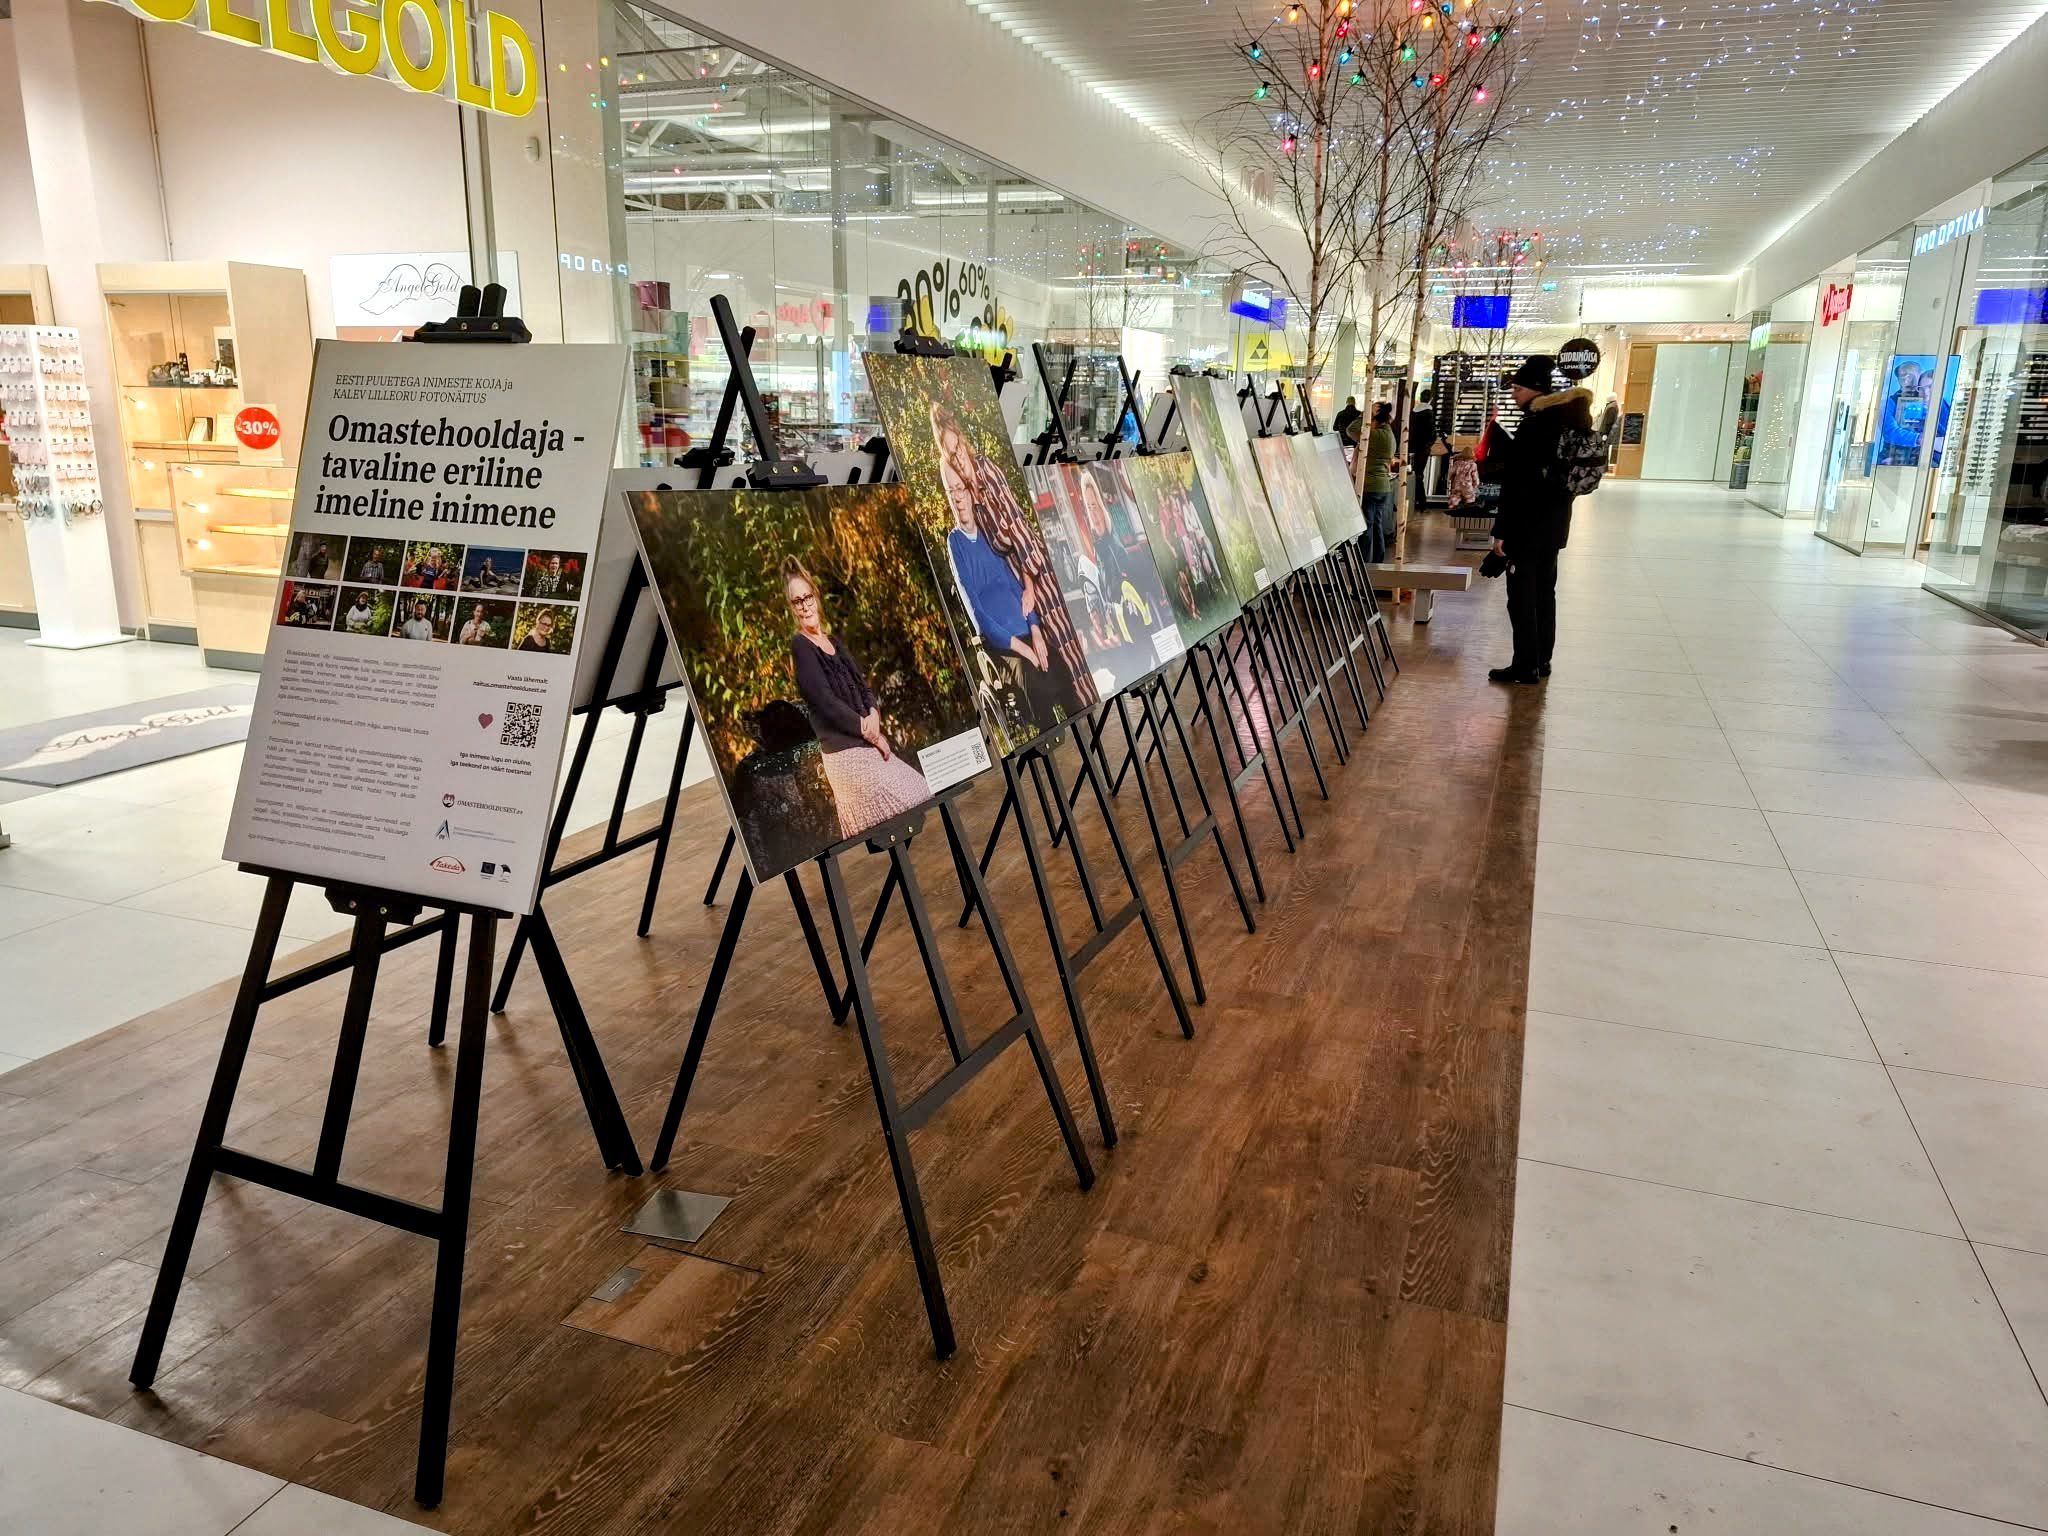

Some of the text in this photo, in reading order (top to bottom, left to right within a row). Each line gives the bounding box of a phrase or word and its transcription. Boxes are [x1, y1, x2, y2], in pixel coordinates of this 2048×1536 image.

[1914, 205, 1984, 257] PRO OPTIKA
[959, 261, 990, 301] 60%
[333, 389, 487, 403] KALEV LILLEORU FOTONÄITUS
[336, 375, 513, 391] EESTI PUUETEGA INIMESTE KOJA ja
[328, 414, 564, 458] Omastehooldaja
[322, 452, 542, 489] tavaline eriline
[314, 485, 556, 529] imeline inimene
